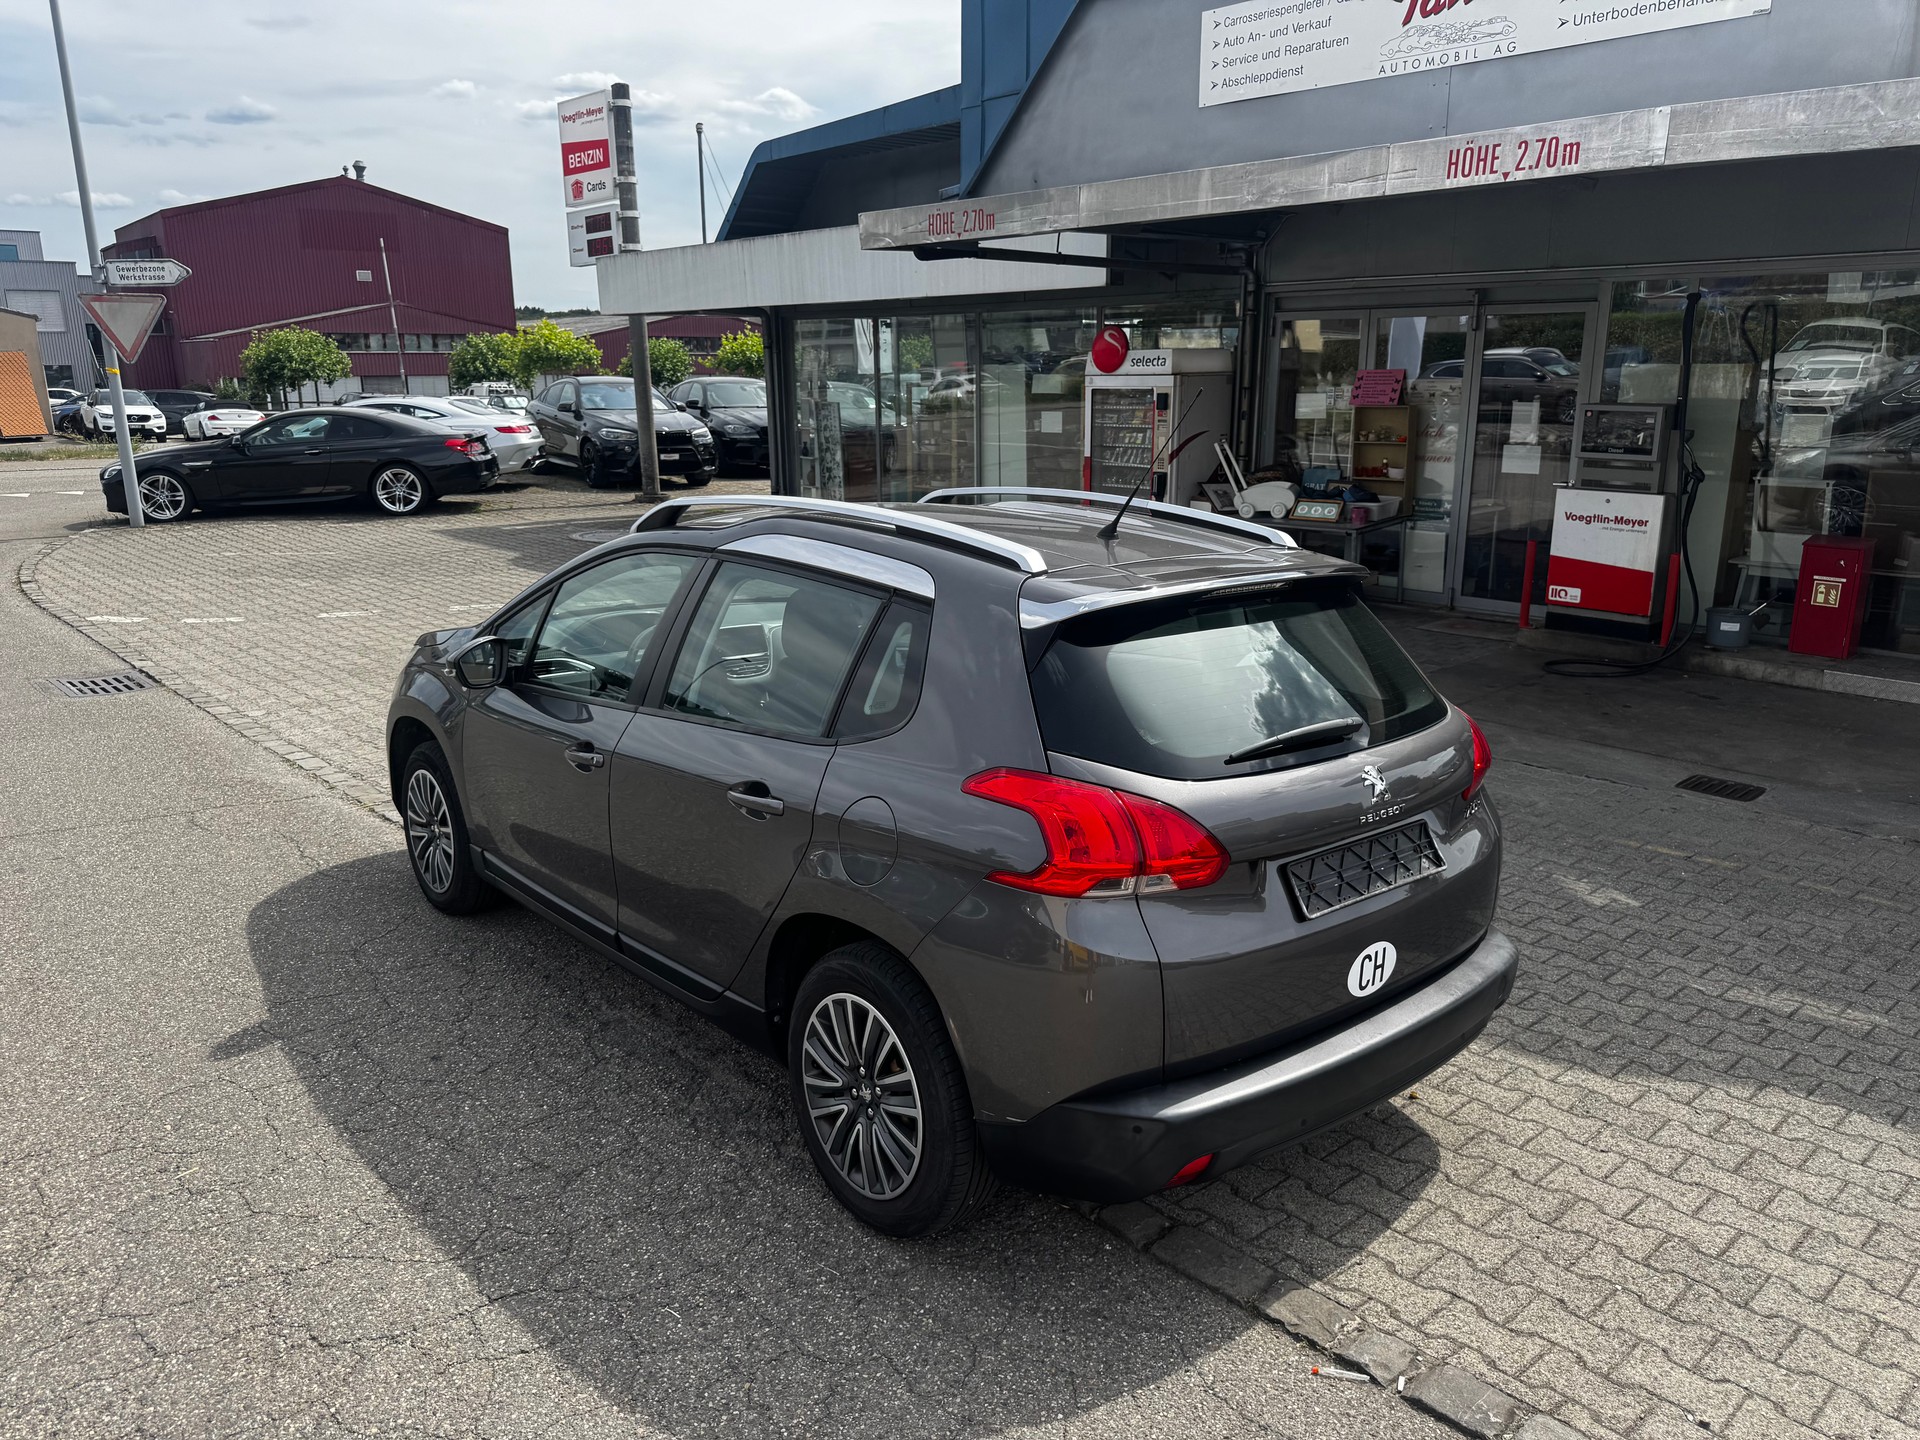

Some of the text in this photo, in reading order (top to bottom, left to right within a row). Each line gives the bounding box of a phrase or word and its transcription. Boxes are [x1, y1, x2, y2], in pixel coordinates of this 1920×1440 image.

[1222, 15, 1332, 48] Auto An- und Verkauf
[1221, 36, 1350, 69] Service und Reparaturen
[1378, 41, 1517, 75] AUTOMOBIL AG
[1221, 64, 1304, 89] Abschleppdienst
[561, 106, 604, 123] Voegtlin-Meyer
[568, 148, 604, 169] BENZIN
[1446, 139, 1502, 180] HÖHE
[587, 180, 606, 192] Cards
[928, 208, 955, 236] HÖHE
[115, 265, 166, 273] Gewerbezone
[118, 273, 166, 281] Werkstrasse
[1130, 355, 1167, 368] selecta
[1636, 432, 1645, 446] 1
[1564, 511, 1649, 528] Voegtlin-Meyer
[1359, 803, 1406, 825] PEUGEOT
[1358, 946, 1387, 992] CH
